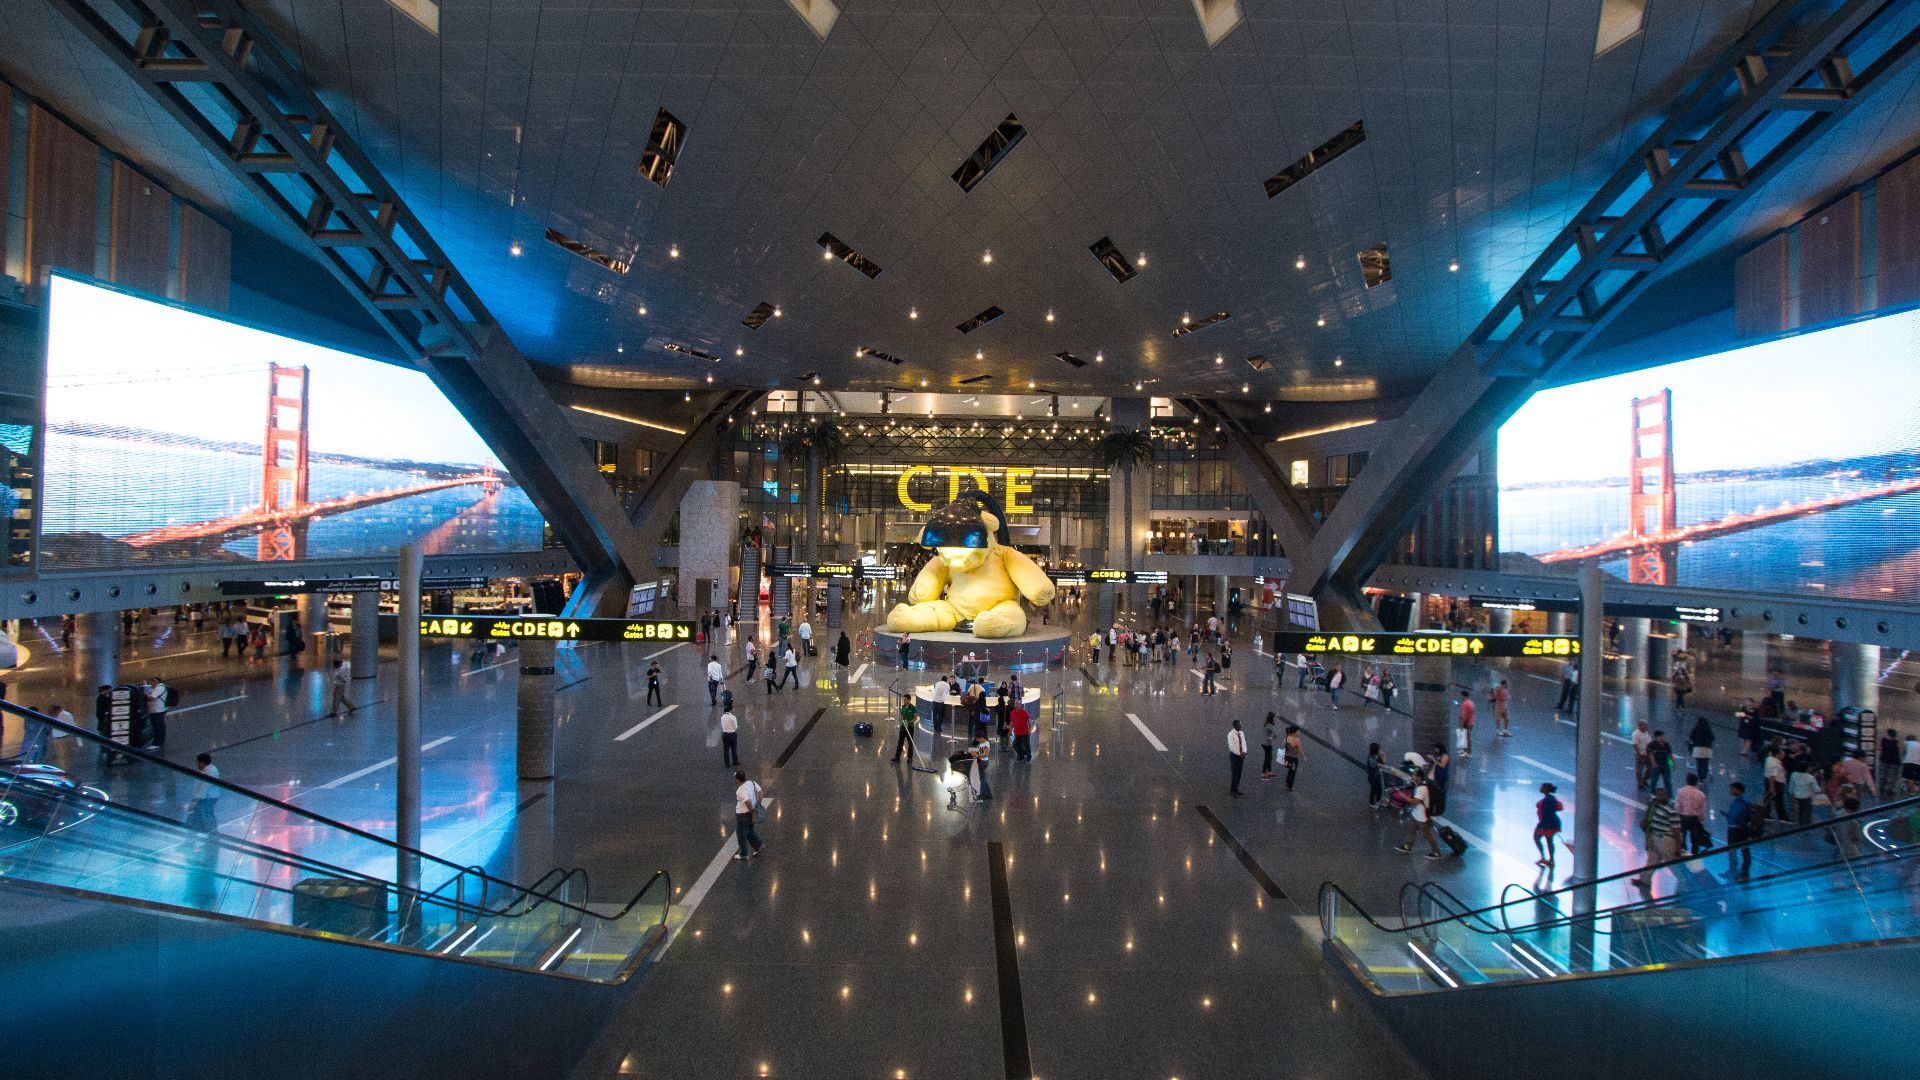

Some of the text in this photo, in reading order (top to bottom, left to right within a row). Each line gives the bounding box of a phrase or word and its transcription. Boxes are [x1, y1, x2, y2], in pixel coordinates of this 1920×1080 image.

[898, 465, 1034, 514] CDE
[428, 620, 441, 633] A
[490, 622, 546, 637] Gates CDE
[623, 624, 655, 639] Gates B
[1327, 637, 1341, 650] A
[1393, 638, 1451, 653] Gates CDE
[1542, 639, 1554, 653] B
